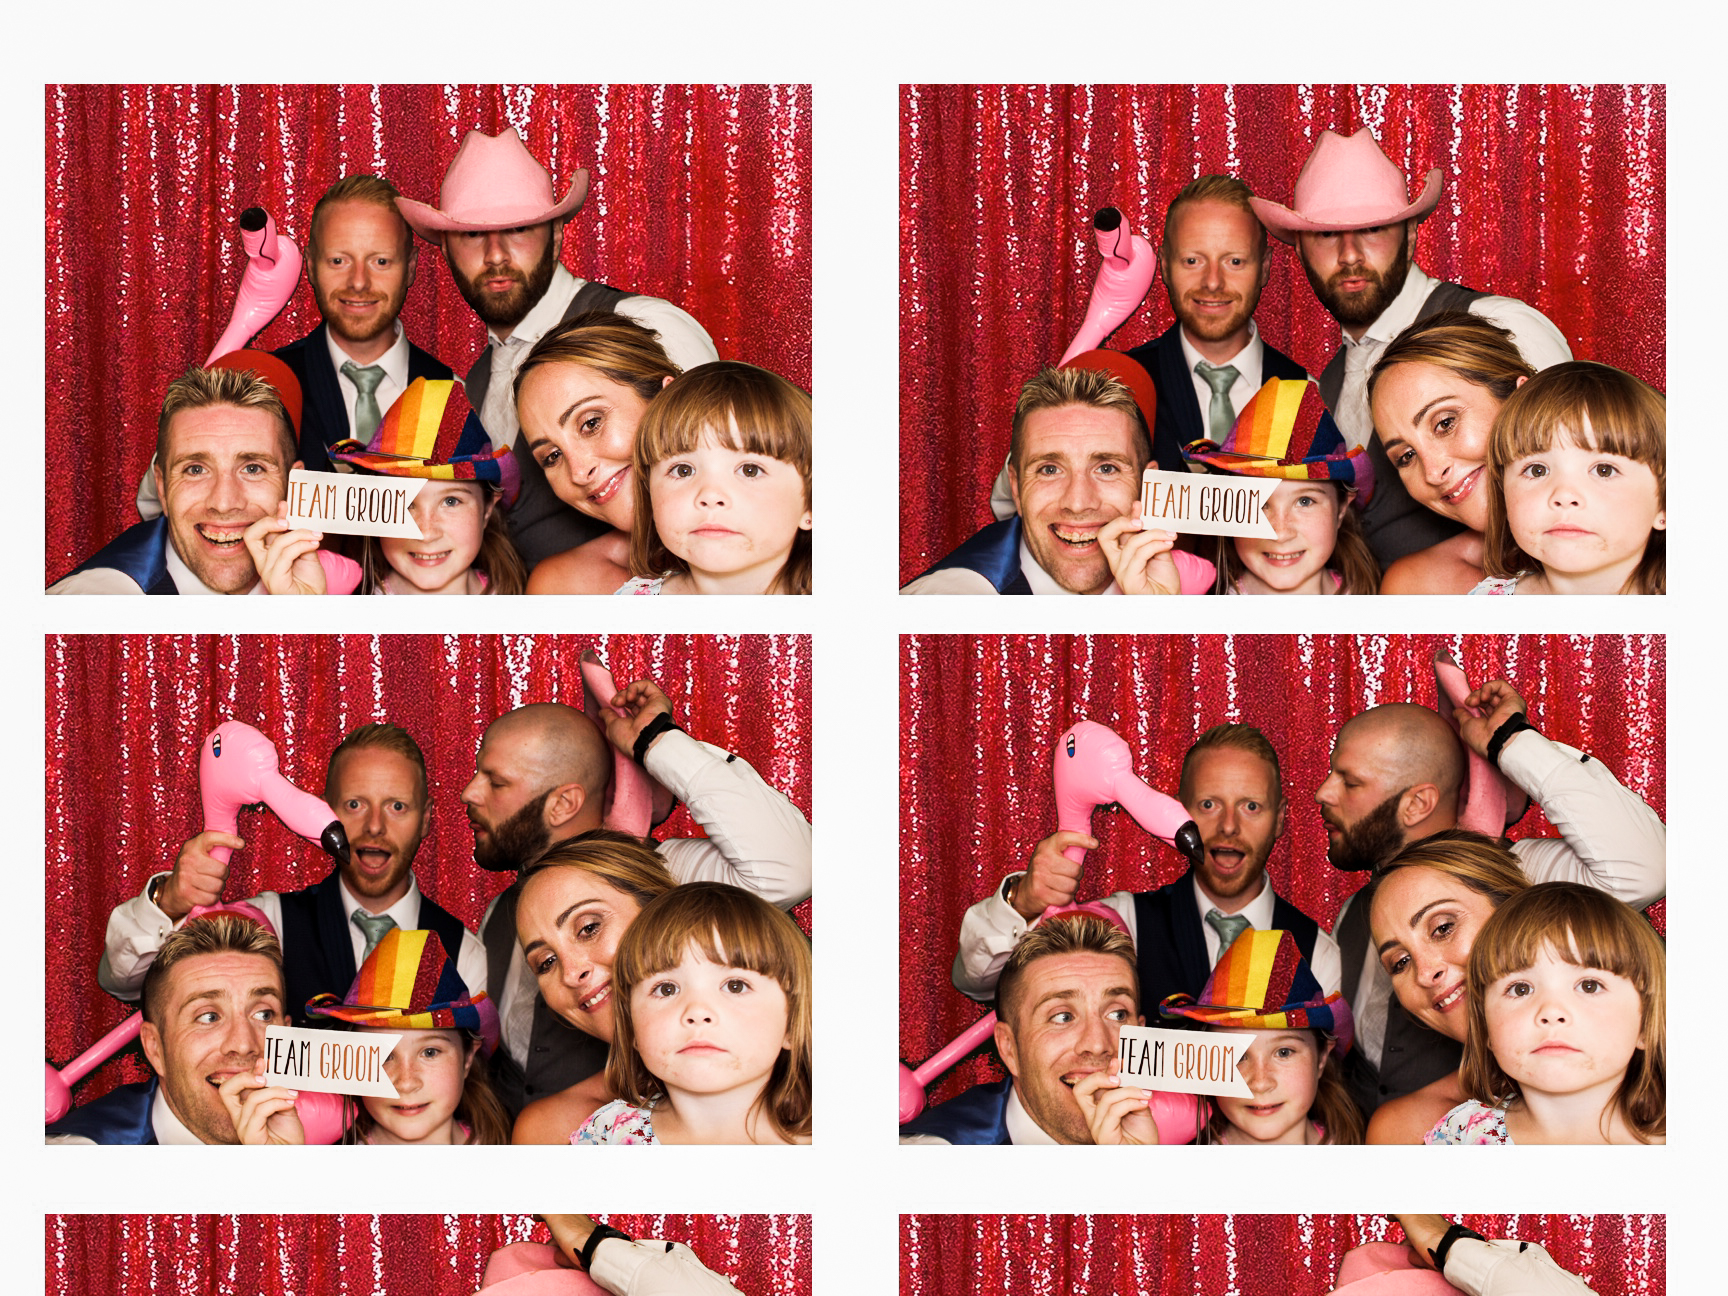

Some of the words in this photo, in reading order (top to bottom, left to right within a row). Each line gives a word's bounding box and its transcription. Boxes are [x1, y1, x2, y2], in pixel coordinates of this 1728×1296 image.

[289, 481, 337, 520] TEAM
[345, 486, 406, 524] GROOM
[1143, 481, 1191, 520] TEAM
[1199, 486, 1260, 524] GROOM
[265, 1037, 311, 1077] TEAM
[319, 1042, 380, 1083] GROOM
[1119, 1037, 1165, 1077] TEAM
[1173, 1042, 1234, 1083] GROOM
